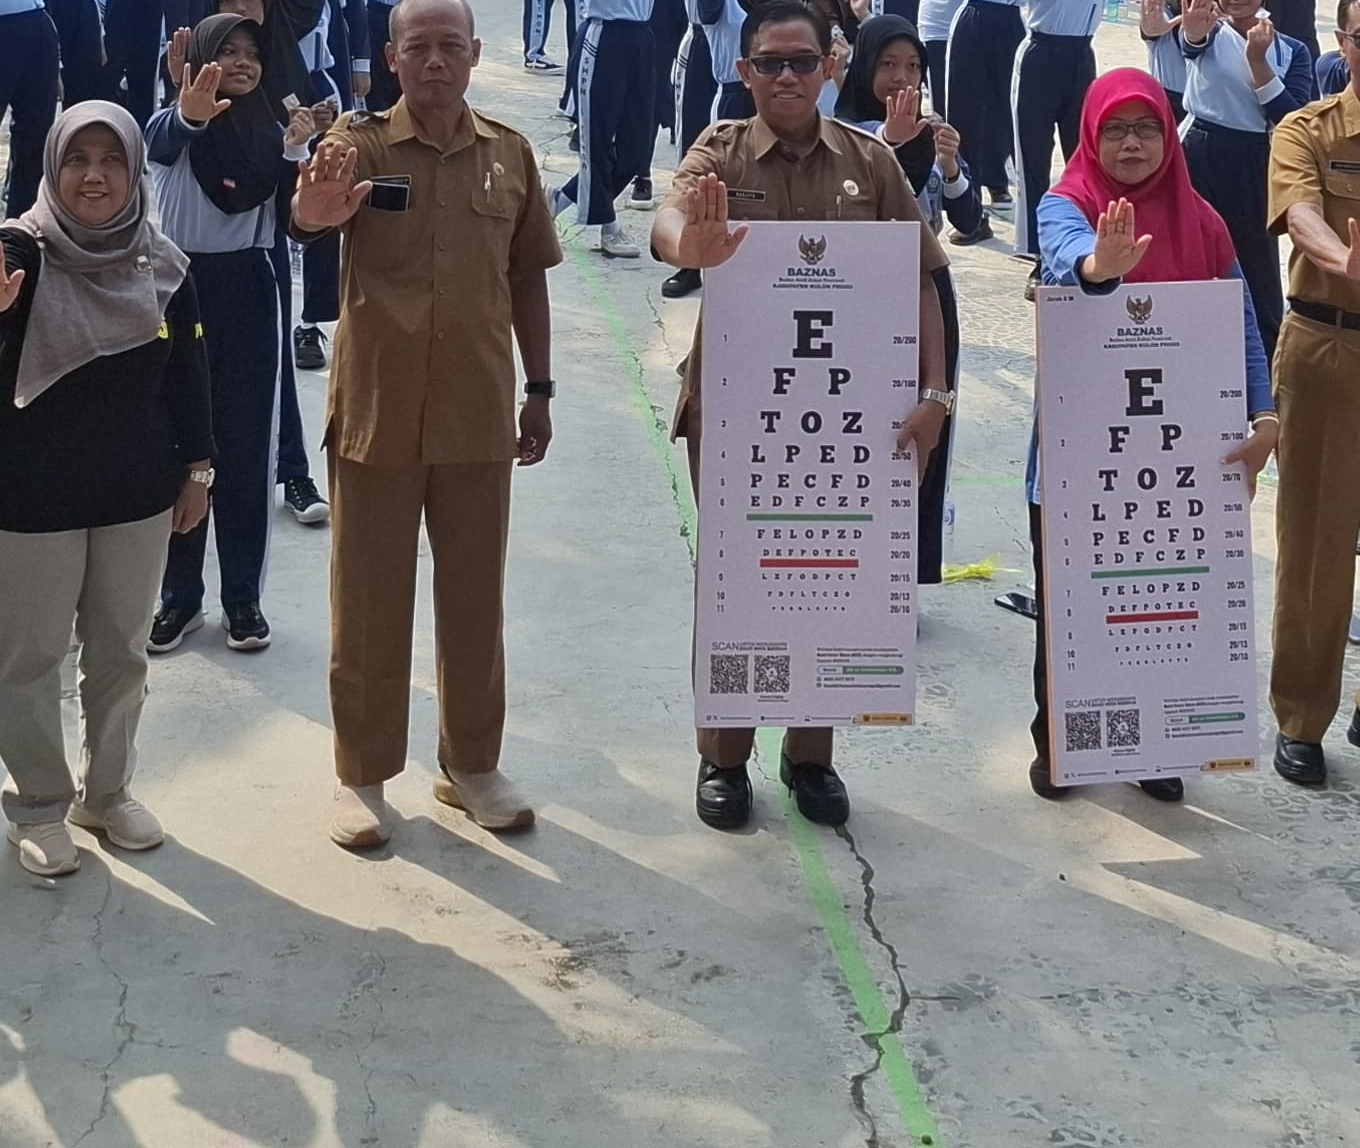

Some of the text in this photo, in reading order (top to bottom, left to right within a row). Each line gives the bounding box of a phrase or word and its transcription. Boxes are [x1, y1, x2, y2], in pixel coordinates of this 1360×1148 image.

[788, 268, 836, 276] BAZNAS
[793, 311, 833, 358] E
[1117, 327, 1163, 336] BAZNAS
[1125, 369, 1163, 416] E
[1220, 390, 1242, 398] 20/200
[712, 642, 739, 650] SCAN
[1066, 700, 1090, 708] SCAN
